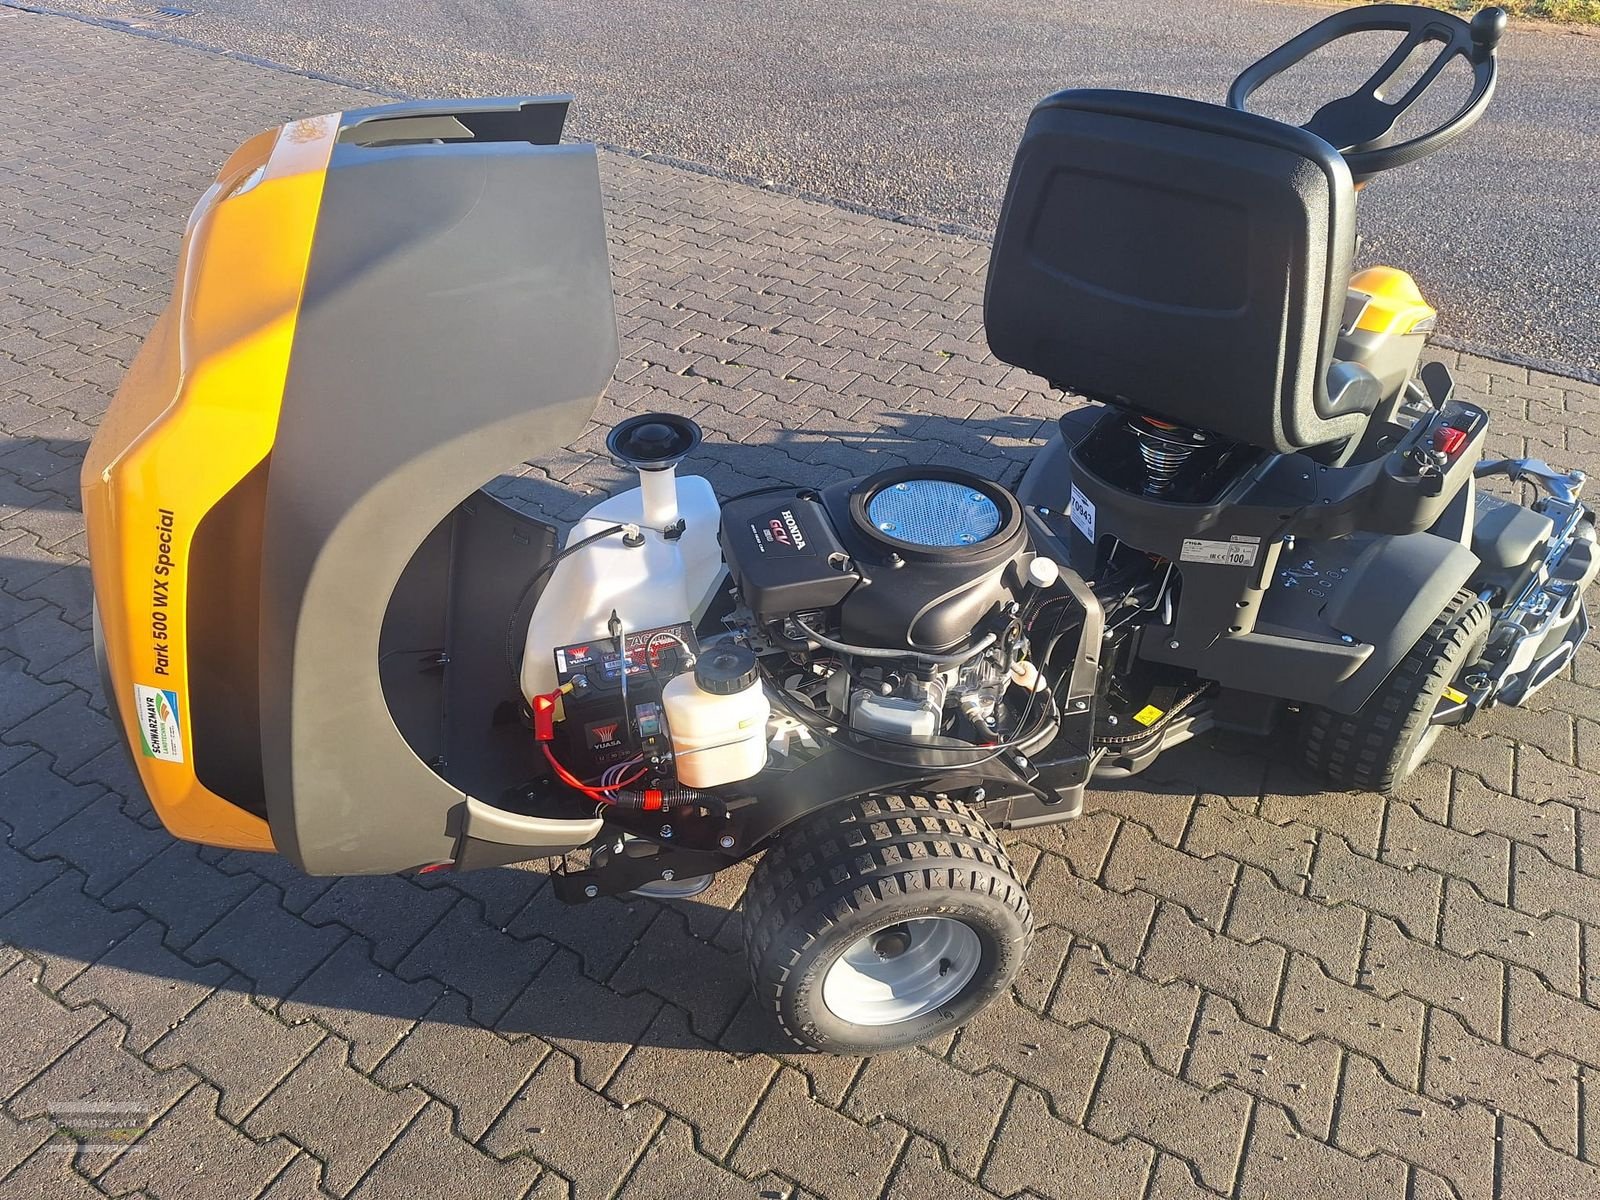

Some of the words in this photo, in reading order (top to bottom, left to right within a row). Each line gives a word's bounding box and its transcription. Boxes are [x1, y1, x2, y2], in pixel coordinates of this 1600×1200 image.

[154, 508, 175, 577] Special
[768, 519, 792, 546] GCV
[781, 509, 806, 551] HONDA
[1230, 553, 1245, 563] 100
[153, 579, 169, 608] WX
[152, 611, 168, 640] 500
[154, 642, 170, 676] Park
[568, 656, 593, 665] YUASA
[146, 697, 161, 754] SCHWARZMAYR
[594, 739, 622, 750] YUASA
